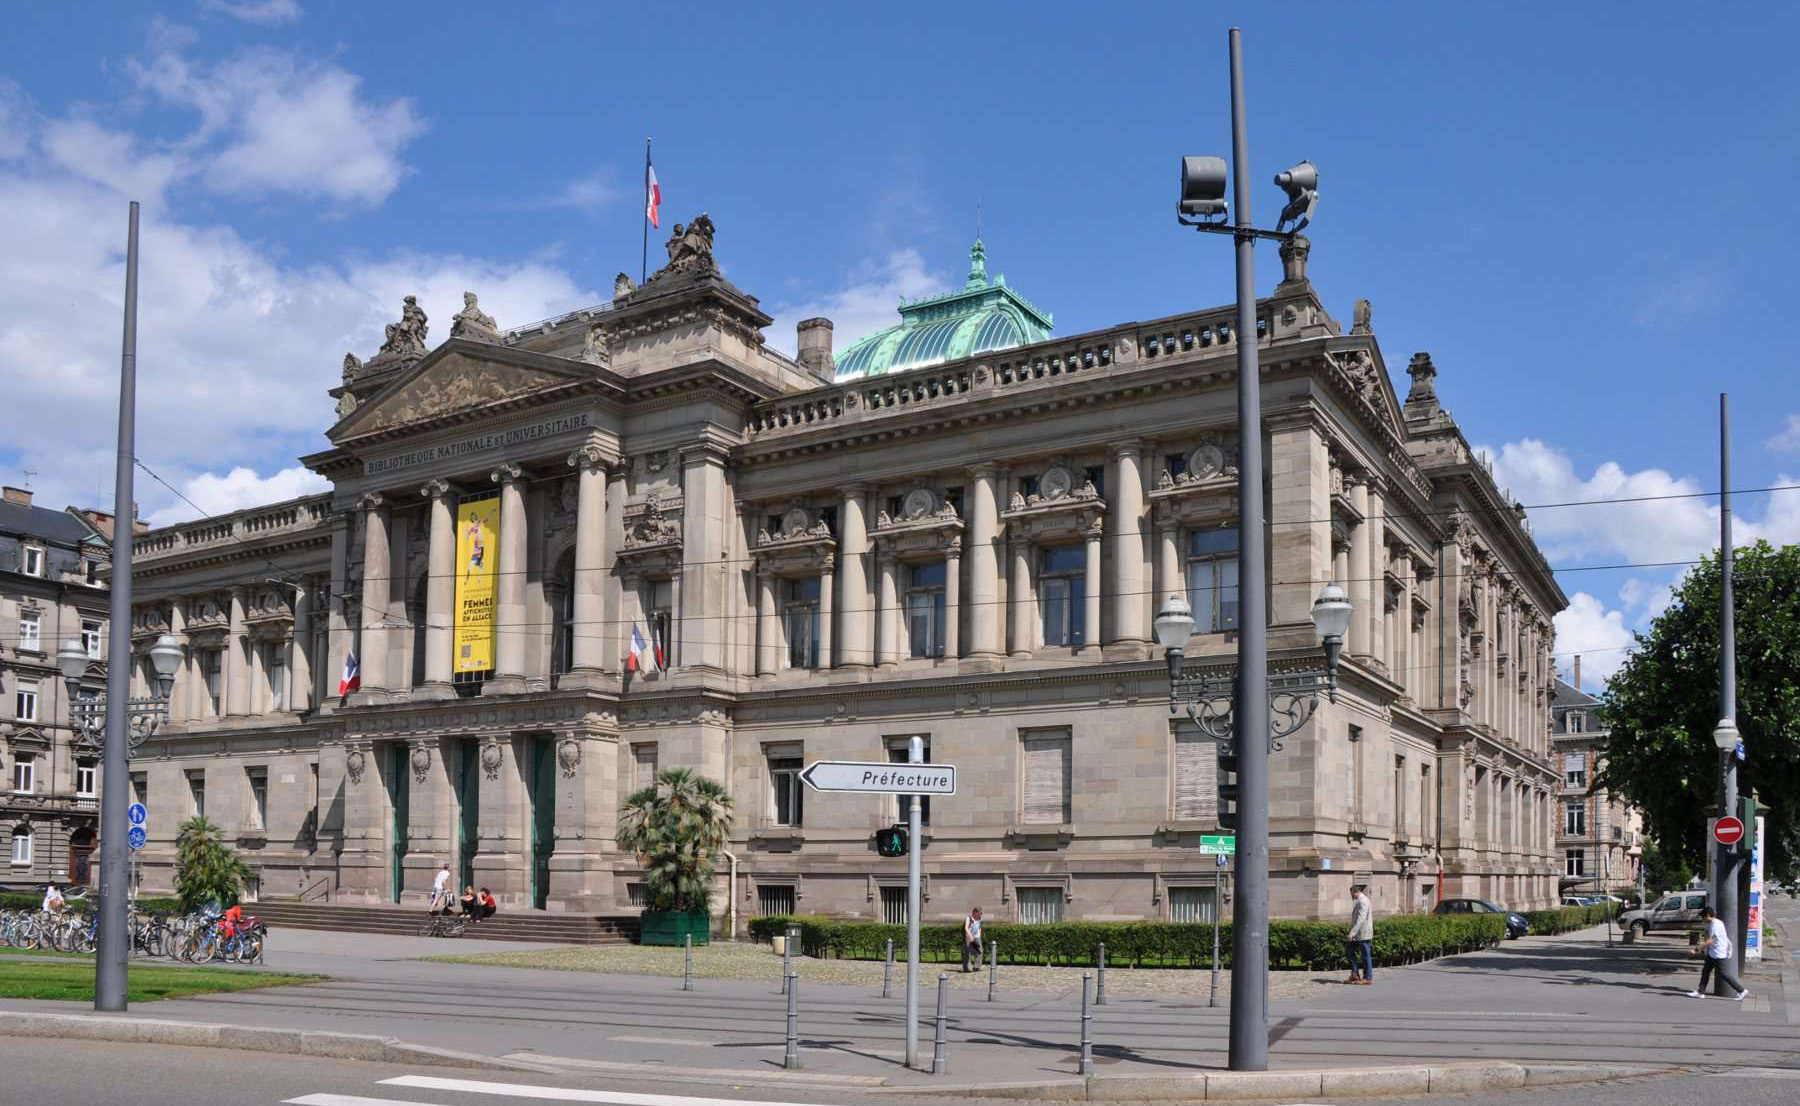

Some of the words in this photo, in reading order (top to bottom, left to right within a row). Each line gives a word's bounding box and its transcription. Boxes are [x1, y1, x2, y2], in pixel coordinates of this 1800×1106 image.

[437, 435, 493, 458] NATIONALE
[506, 415, 588, 443] UNIVERSITAIRE
[862, 771, 948, 787] Préfecture
